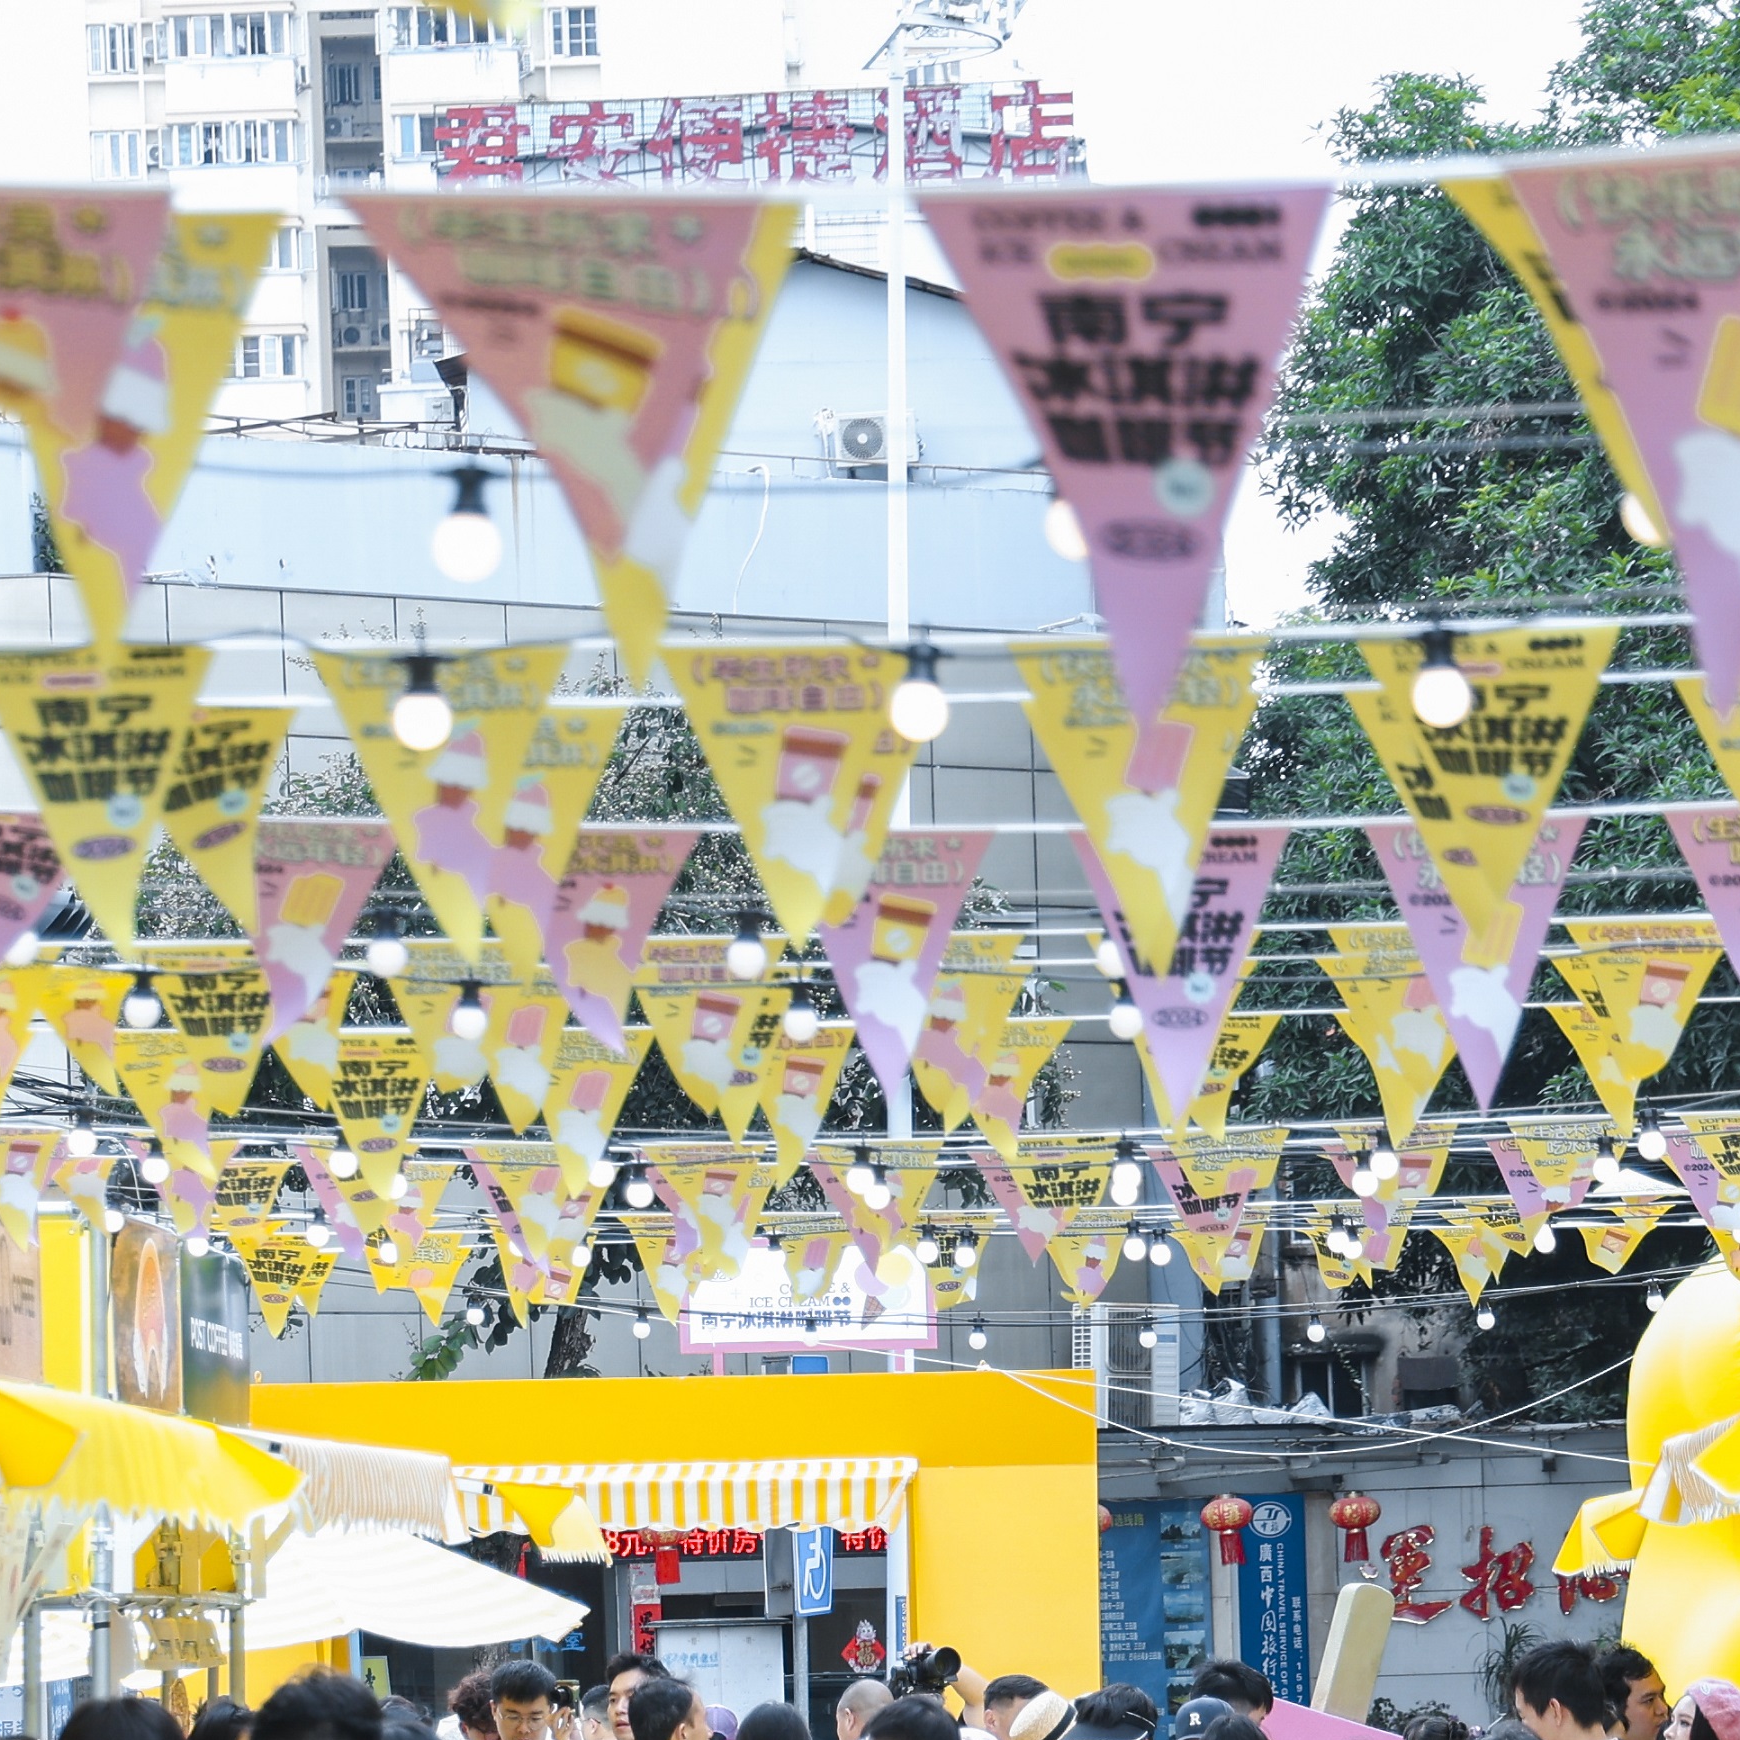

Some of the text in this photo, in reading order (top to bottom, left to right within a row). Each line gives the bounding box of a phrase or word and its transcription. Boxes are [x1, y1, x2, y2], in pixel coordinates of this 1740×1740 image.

[1040, 294, 1231, 347] 南宁
[1011, 355, 1261, 408] 冰淇淋
[35, 695, 153, 729] 南宁
[25, 731, 172, 767] 冰淇淋
[1435, 751, 1563, 778] 咖啡节
[43, 766, 159, 803] 咖啡节
[180, 974, 259, 993] 南宁
[171, 993, 269, 1016] 冰淇淋
[184, 1016, 261, 1037] 咖啡节
[341, 1060, 408, 1077] 南宁
[332, 1077, 420, 1097] 冰淇淋
[343, 1099, 413, 1120] 咖啡节
[1034, 1161, 1090, 1181] 南宁
[1025, 1179, 1100, 1198] 冰淇淋
[1179, 1191, 1241, 1216] 咖啡节
[255, 1249, 300, 1261] 南宁
[248, 1259, 306, 1276] 冰淇淋
[254, 1269, 302, 1287] 咖啡节
[841, 1283, 851, 1293] &
[749, 1297, 773, 1308] ICE
[190, 1316, 206, 1353] POST
[207, 1322, 228, 1357] COFFEE
[679, 1529, 756, 1556] 特价房
[1276, 1542, 1285, 1577] CHINA
[1277, 1579, 1285, 1619] TRAVEL
[856, 1641, 875, 1666] 福
[1278, 1623, 1287, 1668] SERVICE
[1280, 1670, 1288, 1686] OF
[1189, 1713, 1201, 1726] R
